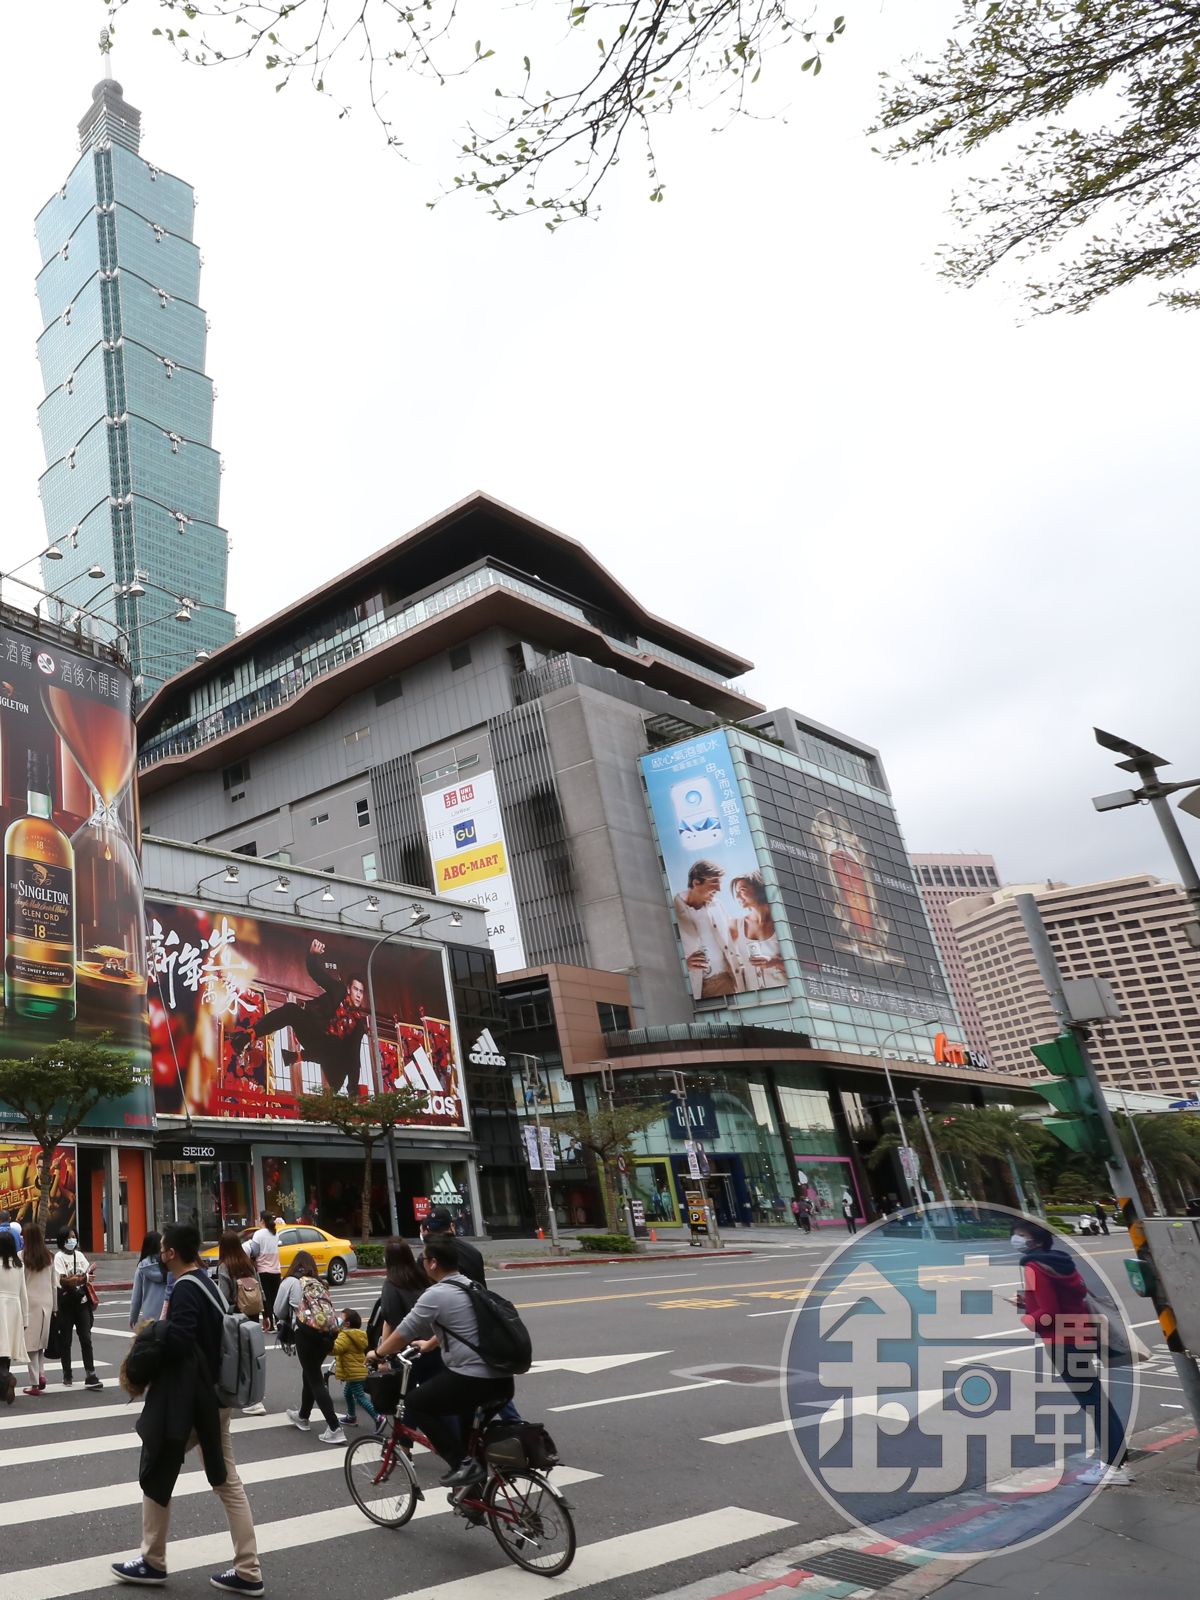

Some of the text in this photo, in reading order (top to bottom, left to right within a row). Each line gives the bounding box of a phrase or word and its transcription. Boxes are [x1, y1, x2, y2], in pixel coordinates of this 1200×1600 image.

[60, 659, 120, 701] 酒後不開車
[455, 826, 475, 842] GU
[443, 854, 499, 881] ABC-MART
[18, 879, 70, 906] SINGLETON
[465, 891, 498, 905] rshka
[22, 908, 41, 919] GLEN
[44, 912, 60, 922] ORD
[33, 923, 47, 939] 18
[469, 1050, 507, 1067] adidas
[675, 1105, 706, 1127] GAP
[182, 1146, 215, 1157] SEIKO
[431, 1191, 464, 1205] adidas
